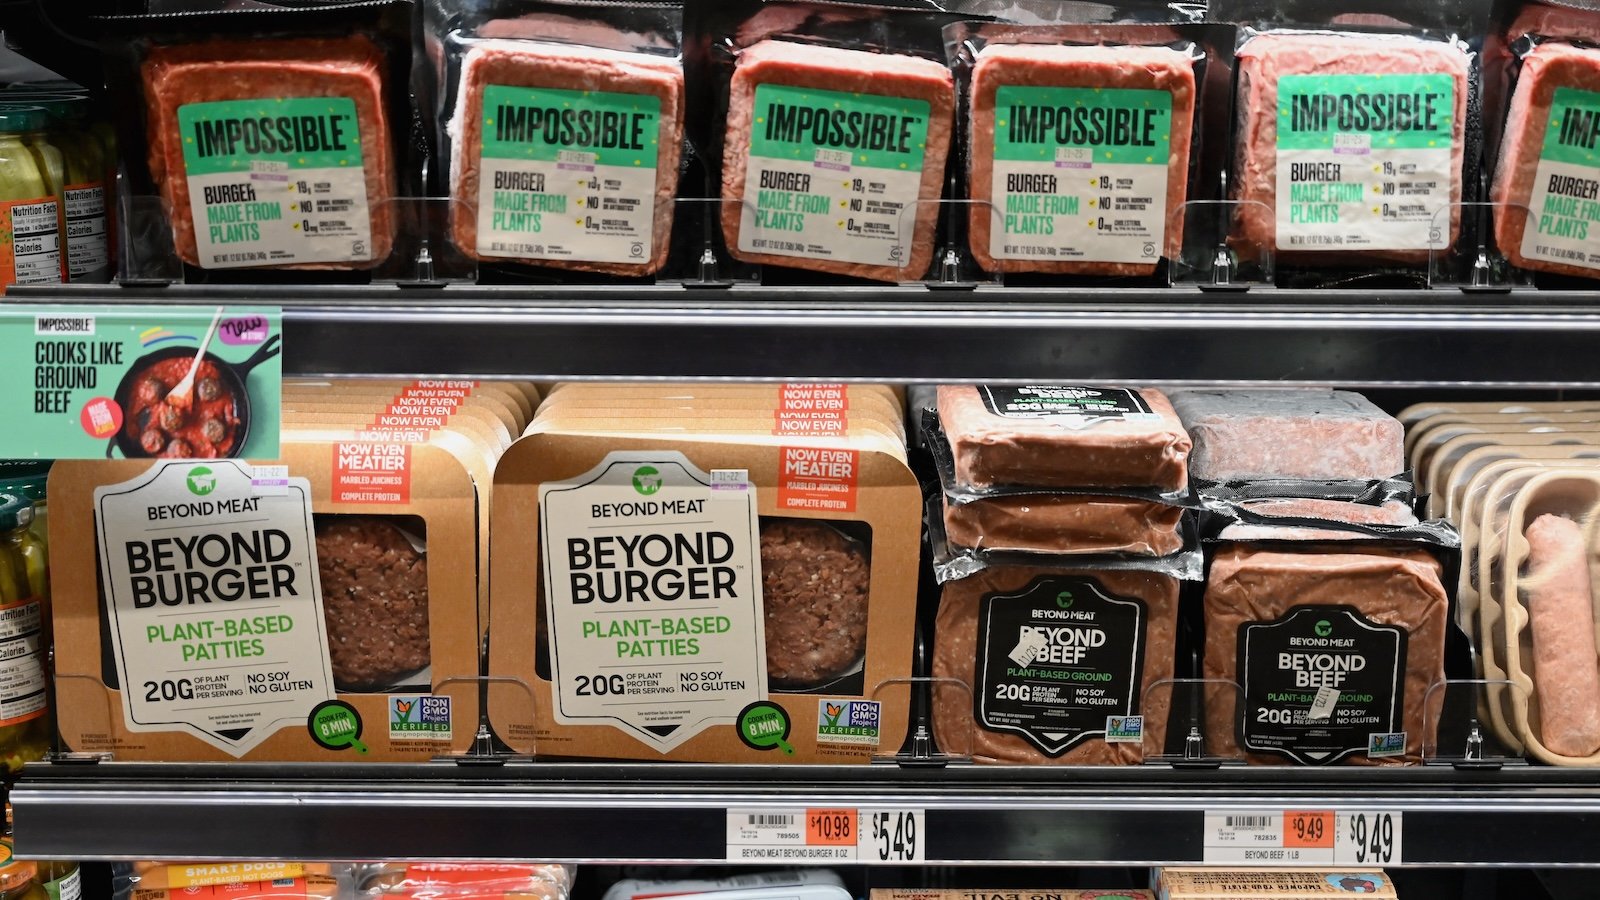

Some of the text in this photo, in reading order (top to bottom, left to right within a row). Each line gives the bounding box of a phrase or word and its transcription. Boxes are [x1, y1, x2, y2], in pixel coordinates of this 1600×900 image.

[1291, 93, 1438, 131] IMPOSSIBLE
[496, 104, 645, 150] IMPOSSIBLE
[766, 103, 914, 154] IMPOSSIBLE
[1008, 105, 1157, 147] IMPOSSIBLE
[194, 114, 347, 158] IMPOSSIBLE
[495, 170, 545, 192] BURGER
[760, 169, 811, 193] BURGER
[1291, 162, 1341, 182] BURGER
[1007, 173, 1057, 194] BURGER
[1547, 174, 1599, 200] BURGER
[204, 183, 256, 205] BURGER
[1290, 183, 1363, 203] MADE FROM
[12, 205, 42, 217] Nutrition
[494, 191, 566, 214] MADE FROM
[757, 190, 831, 215] MADE FROM
[1006, 194, 1079, 215] MADE FROM
[1543, 194, 1579, 218] MADE
[207, 201, 282, 225] MADE FROM
[493, 211, 542, 233] PLANTS
[754, 210, 804, 232] PLANTS
[1290, 204, 1339, 223] PLANTS
[67, 225, 92, 236] Calories
[210, 222, 260, 244] PLANTS
[1005, 214, 1054, 235] PLANTS
[1538, 215, 1588, 240] PLANTS
[15, 243, 42, 253] Calories
[38, 318, 90, 332] IMPOSSIBLE
[220, 317, 262, 337] new
[35, 341, 124, 365] COOKS LIKE
[35, 366, 96, 389] GROUND
[35, 390, 72, 413] BEEF
[338, 444, 405, 456] NOW EVEN
[786, 449, 852, 463] NOW EVEN
[339, 456, 404, 470] MEATIER
[785, 460, 852, 478] MEATIER
[340, 476, 402, 485] MARBLED JUICINESS
[786, 481, 849, 492] MARBLED JUICINESS
[341, 492, 401, 501] COMPLETE PROTEIN
[787, 498, 847, 509] COMPLETE PROTEIN
[147, 497, 260, 521] BEYOND MEAT
[591, 499, 706, 518] BEYOND MEAT
[125, 529, 291, 575] BEYOND
[567, 531, 734, 570] BEYOND
[129, 564, 299, 609] BURGER
[570, 566, 738, 605] BURGER
[1032, 609, 1096, 621] BEYOND MEAT
[146, 615, 294, 643] PLANT-BASED
[582, 616, 731, 638] PLANT-BASED
[182, 638, 265, 662] PATTIES
[617, 638, 700, 658] PATTIES
[1290, 637, 1355, 647] BEYOND MEAT
[1035, 645, 1086, 664] BEEF
[1278, 653, 1366, 671] BEYOND
[247, 671, 290, 684] NO SOY
[680, 671, 723, 681] NO SOY
[1007, 668, 1112, 681] PLANT-BASED GROUND
[1295, 670, 1346, 687] BEEF
[143, 678, 194, 702] 20G
[205, 674, 230, 683] PLANT
[194, 682, 227, 691] PROTEIN
[196, 689, 244, 699] PER SERVING
[248, 680, 313, 695] NO GLUTEN
[574, 674, 625, 696] 20G
[627, 686, 675, 695] PER SERVING
[681, 681, 745, 692] NO GLUTEN
[995, 683, 1031, 701] 20G
[1089, 689, 1105, 697] SOY
[422, 698, 448, 707] NON
[423, 706, 448, 715] GMO
[852, 703, 878, 712] NON
[1075, 697, 1118, 706] NO GLUTEN
[318, 712, 348, 724] COOK FOR
[422, 714, 448, 723] Project
[748, 712, 777, 724] COOK FOR
[851, 711, 878, 721] GMO
[851, 719, 877, 727] Project
[1257, 707, 1291, 724] 20G
[1350, 716, 1380, 724] GLUTEN
[320, 718, 355, 736] 8 MIN.
[750, 719, 784, 736] 8 MIN.
[822, 727, 877, 736] VERIFIED
[872, 811, 915, 861] $5.49
[1350, 813, 1393, 863] $9.49
[742, 848, 766, 857] BEYOND
[767, 848, 783, 857] MEAT
[784, 848, 808, 857] BEYOND
[808, 848, 833, 857] BURGER
[840, 848, 848, 857] OZ
[1245, 850, 1269, 859] BEYOND
[1270, 850, 1285, 859] BEEF
[1291, 850, 1299, 859] LB
[185, 864, 238, 877] SMART
[190, 871, 284, 885] PLANT-BASED HOT DOGS
